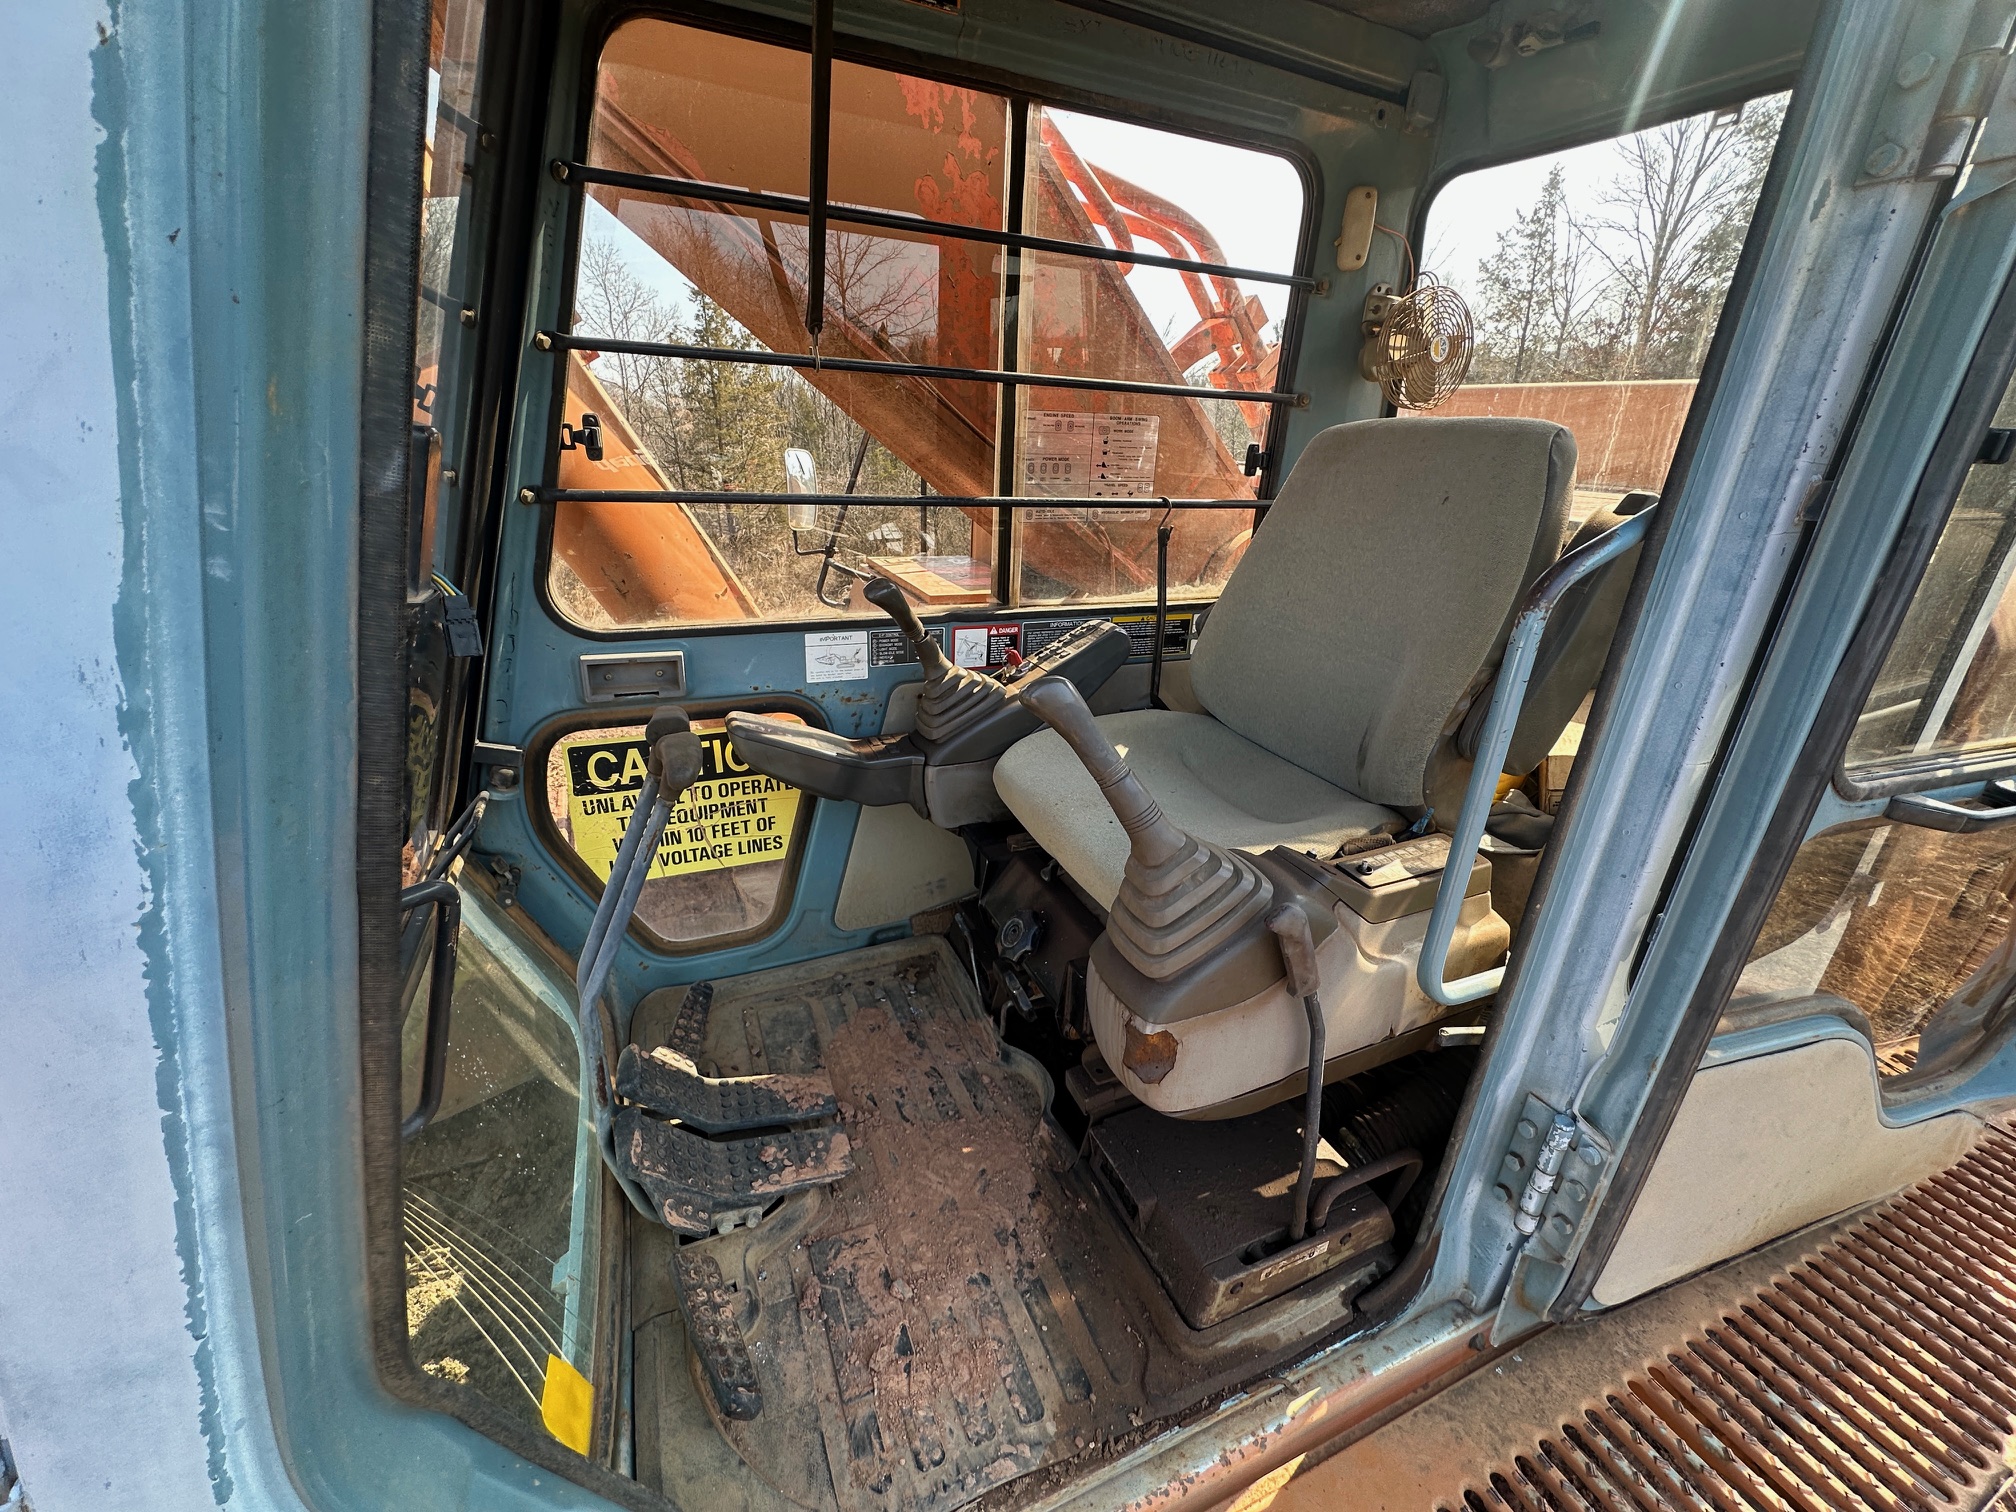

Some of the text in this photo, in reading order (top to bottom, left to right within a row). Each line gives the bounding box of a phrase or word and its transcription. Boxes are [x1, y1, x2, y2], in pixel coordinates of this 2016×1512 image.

[998, 626, 1019, 634] DANGER
[1049, 620, 1084, 628] INFORMATIO
[587, 739, 750, 788] CAIO
[686, 784, 712, 803] TO
[667, 797, 768, 826] EQUIPMENT
[686, 826, 705, 843] 10
[712, 819, 751, 839] FEET
[756, 815, 776, 832] OF
[659, 842, 733, 867] VOLTAGE
[738, 835, 783, 856] LINES
